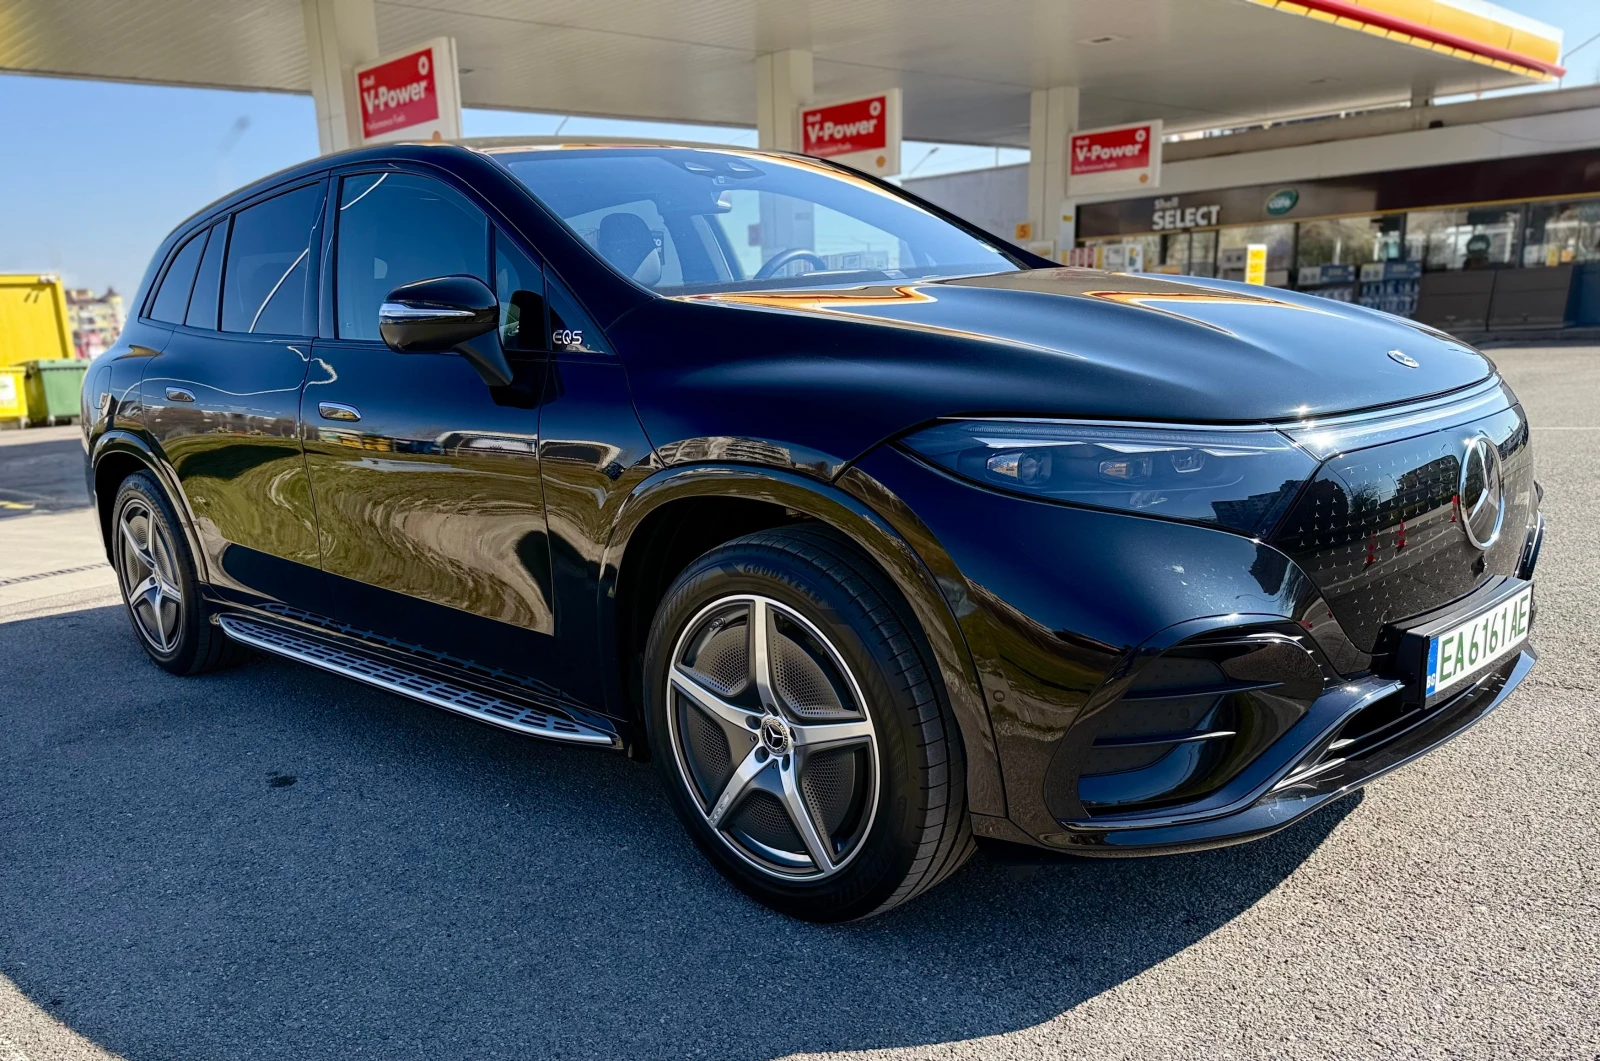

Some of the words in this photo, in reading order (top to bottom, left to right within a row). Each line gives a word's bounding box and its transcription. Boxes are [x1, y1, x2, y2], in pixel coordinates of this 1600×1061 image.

[363, 80, 427, 114] V-Power
[806, 119, 877, 143] V-Power
[1075, 143, 1142, 162] V-Power
[1152, 204, 1221, 231] SELECT
[552, 329, 583, 345] EQS
[1426, 673, 1437, 689] BG
